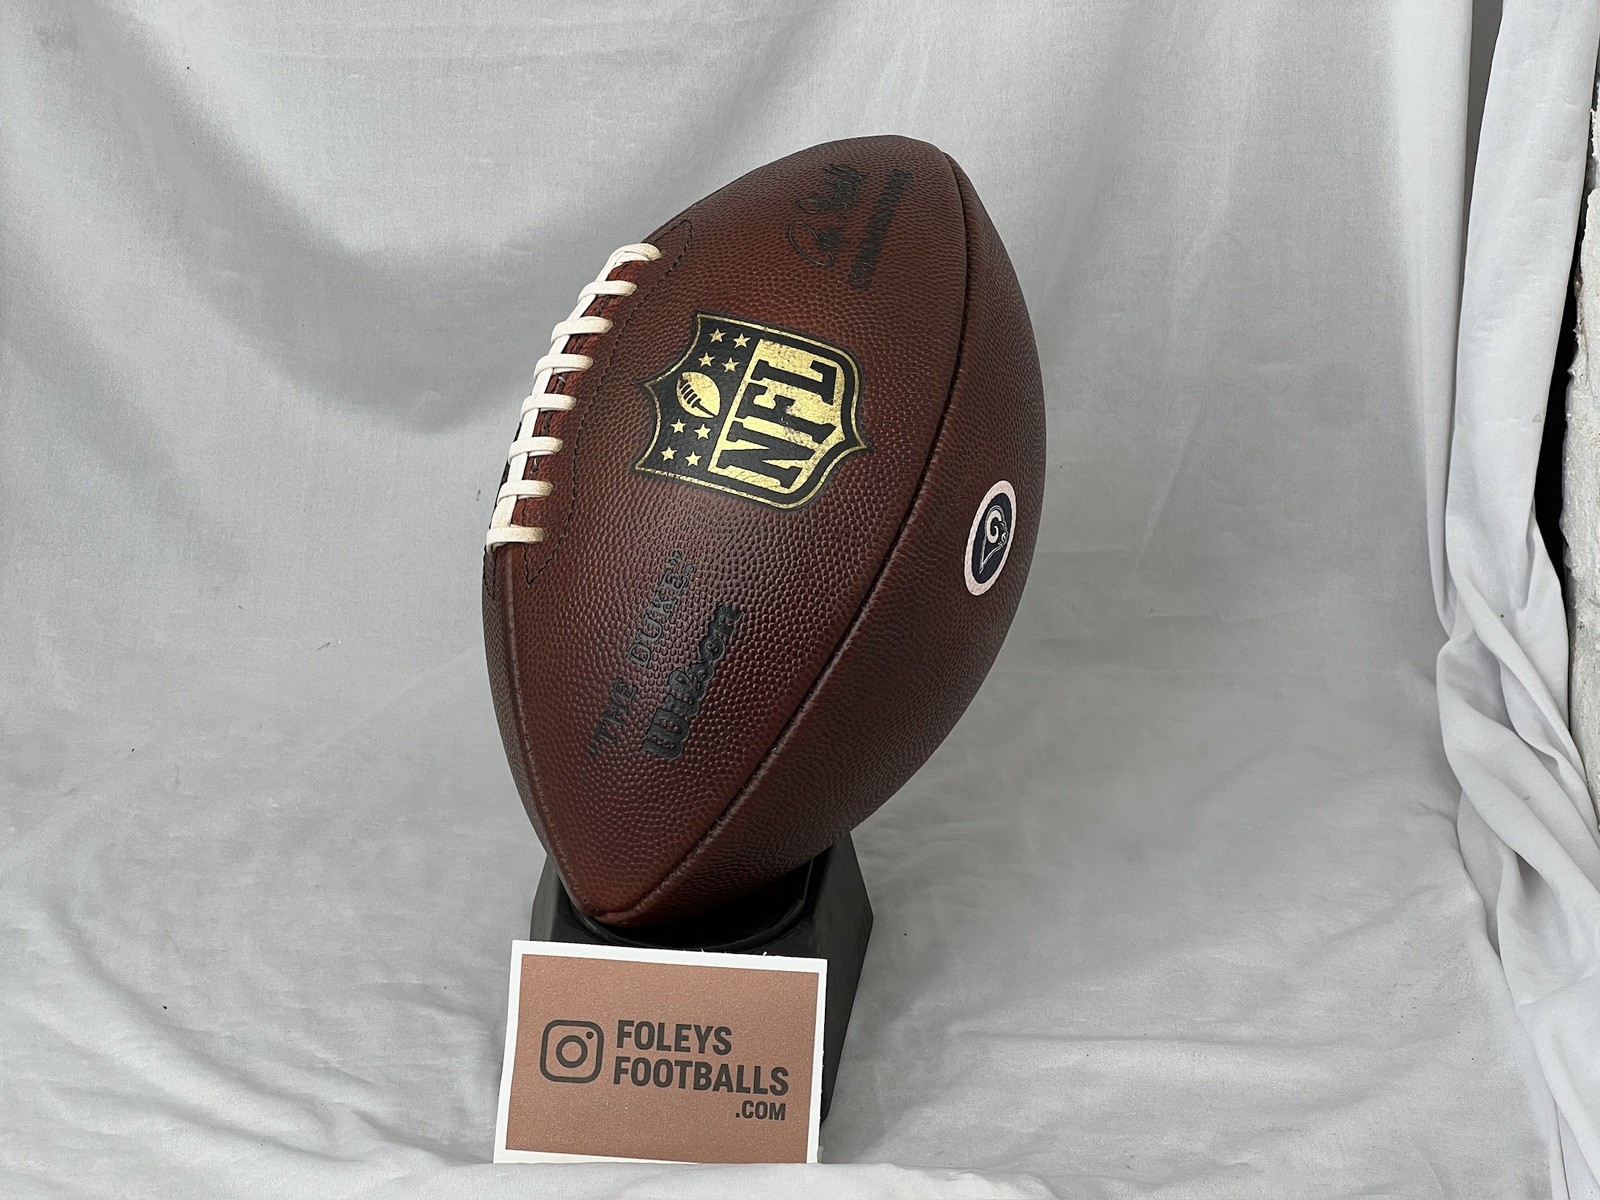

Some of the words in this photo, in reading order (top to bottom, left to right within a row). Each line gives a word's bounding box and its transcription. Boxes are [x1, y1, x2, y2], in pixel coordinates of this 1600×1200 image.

[714, 359, 838, 490] NFL
[639, 603, 745, 761] Wilson
[616, 1019, 732, 1056] FOLEYS
[613, 1056, 790, 1096] FOOTBALLS
[735, 1099, 787, 1122] .COM
